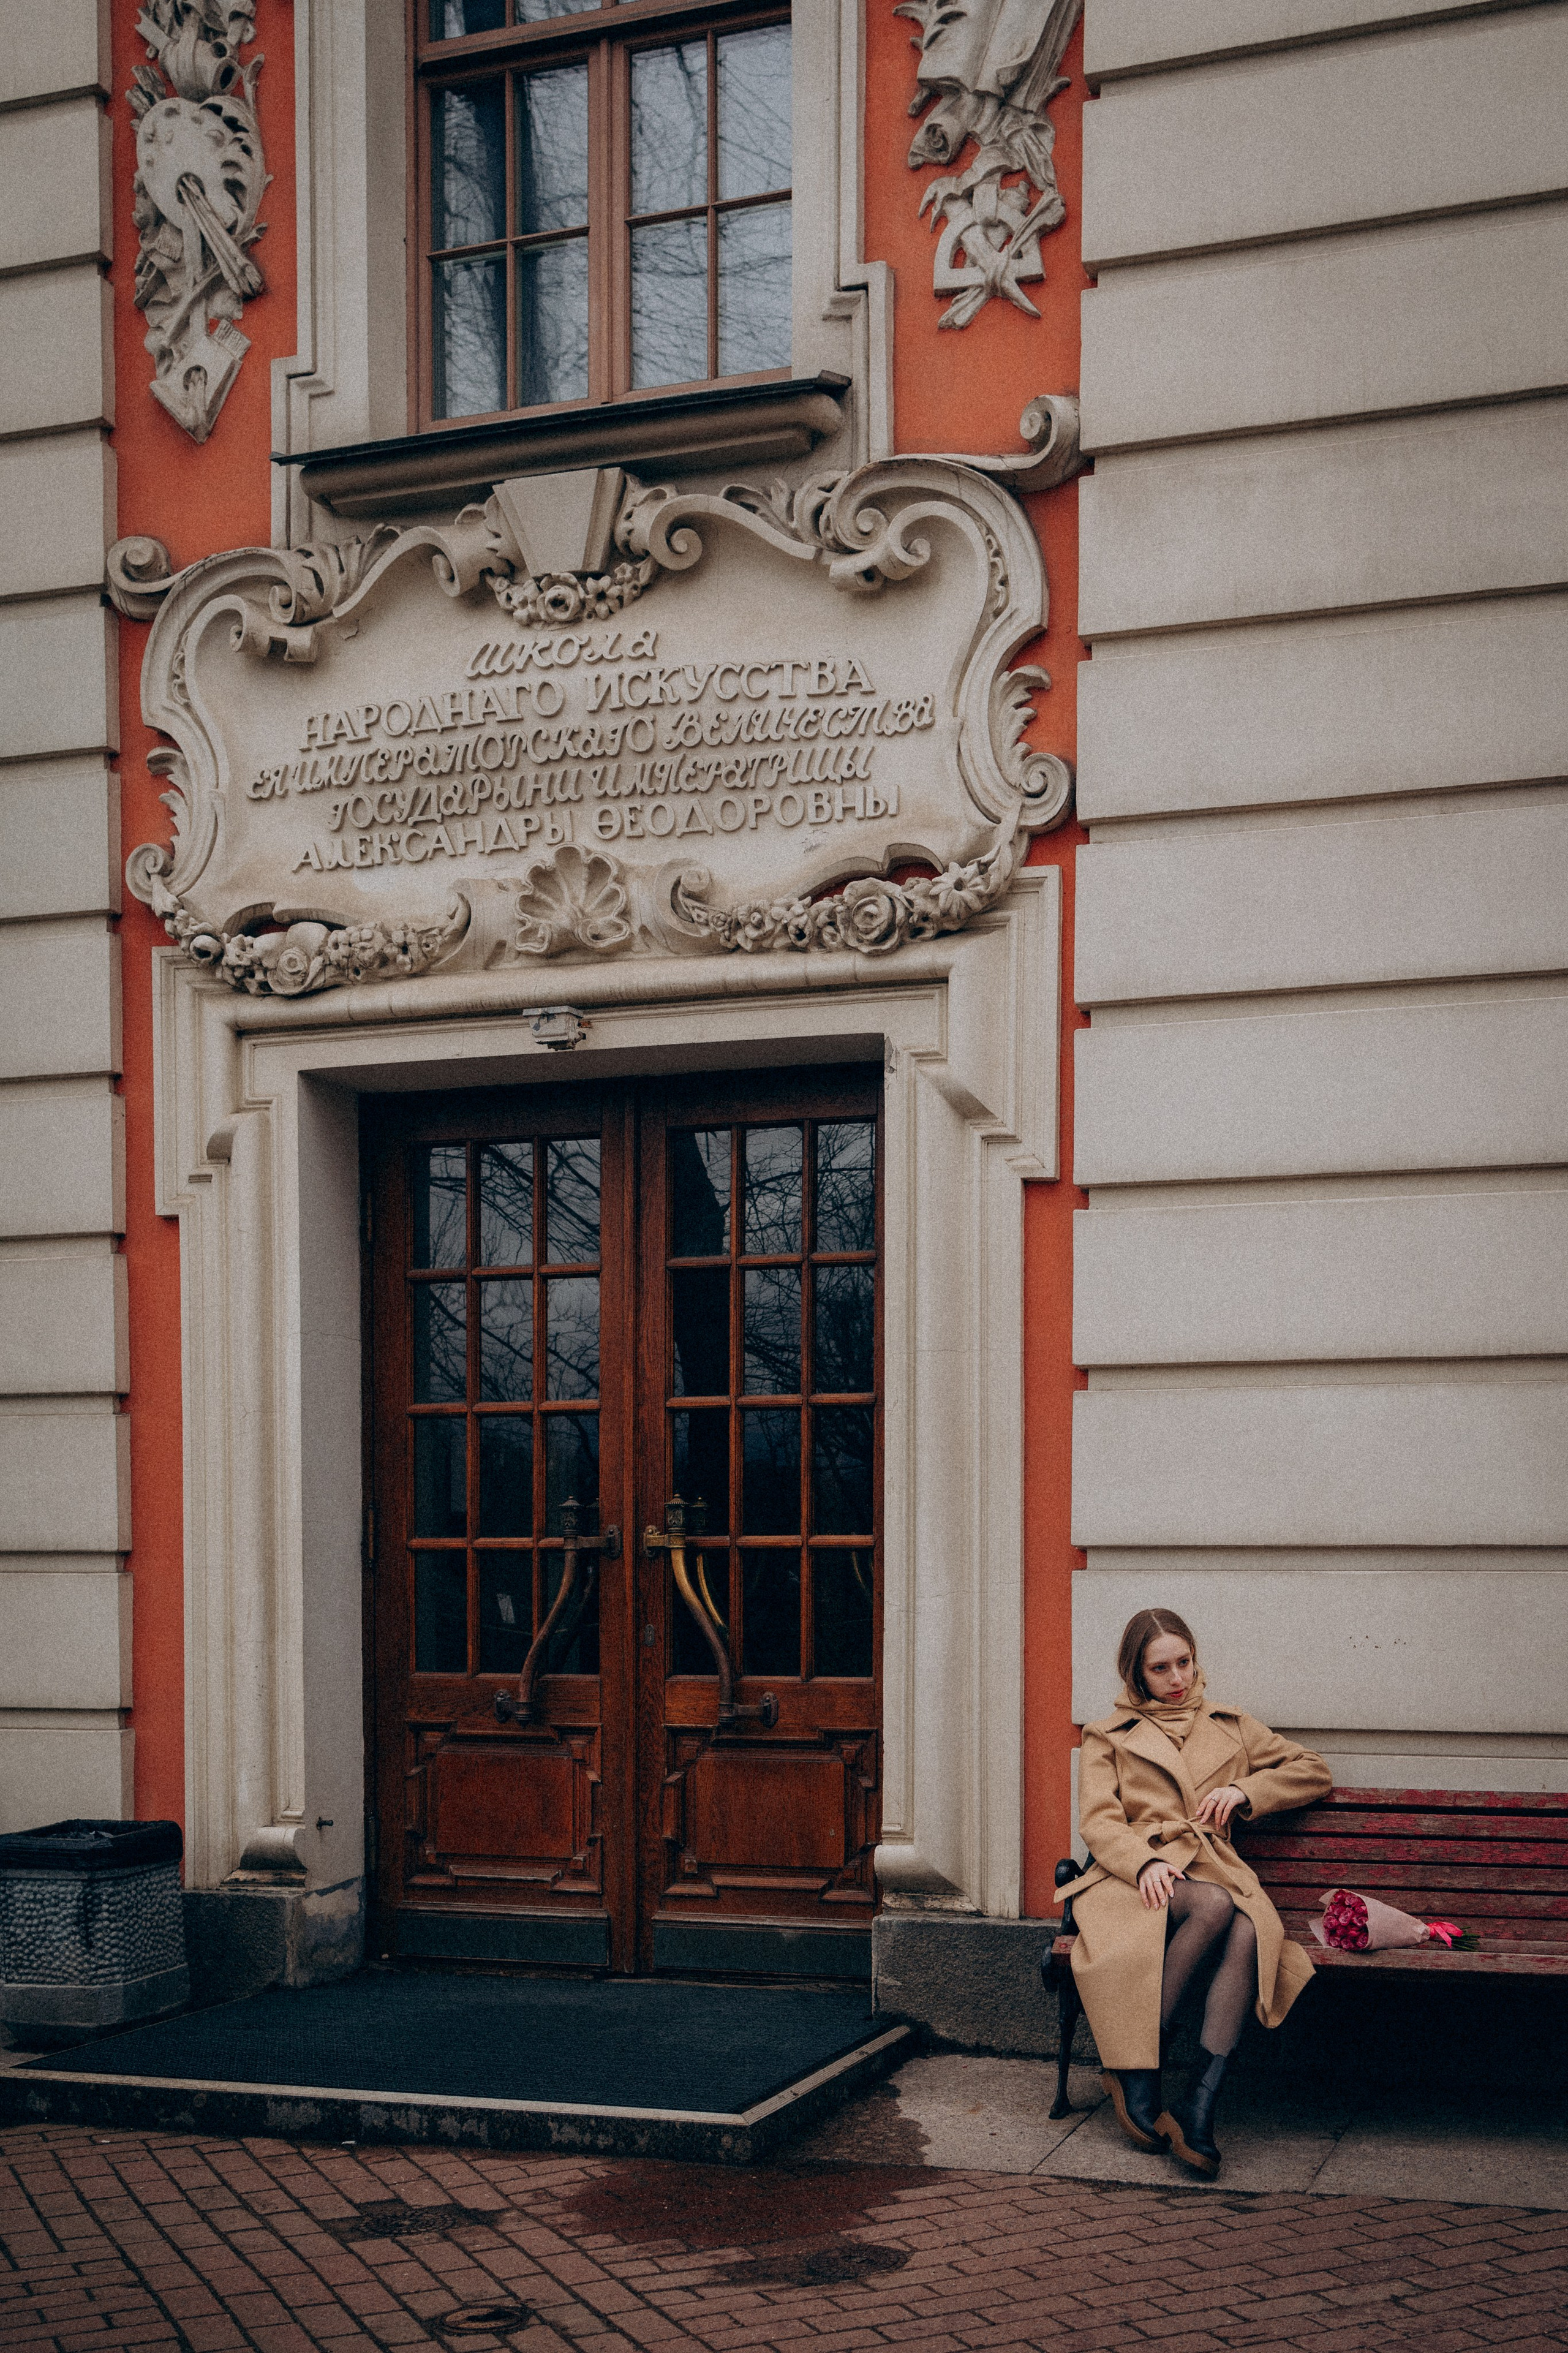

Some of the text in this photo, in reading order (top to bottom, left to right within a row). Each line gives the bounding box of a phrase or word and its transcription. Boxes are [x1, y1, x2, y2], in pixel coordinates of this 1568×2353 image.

[298, 657, 876, 752] НАРОДНАГО ИСКУССТВА
[291, 809, 574, 874] АЛЕКСАНДРЫ
